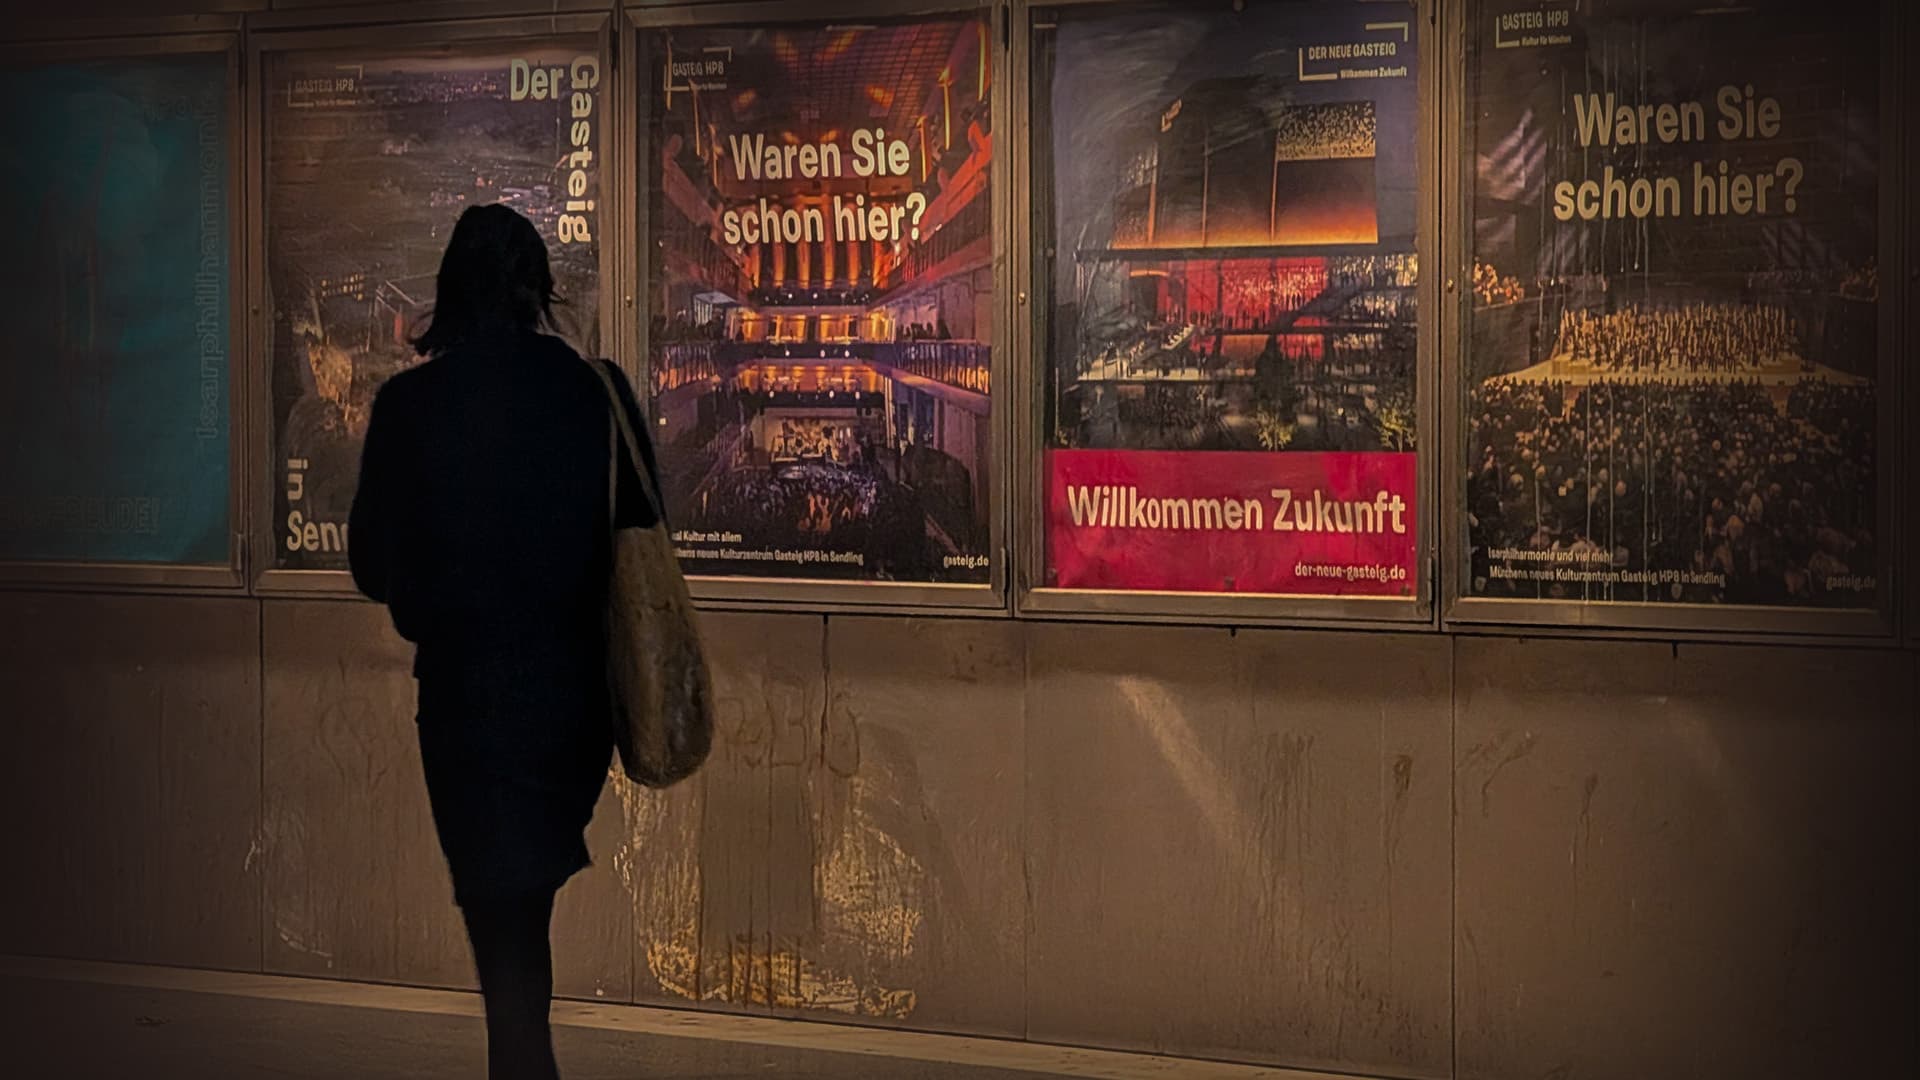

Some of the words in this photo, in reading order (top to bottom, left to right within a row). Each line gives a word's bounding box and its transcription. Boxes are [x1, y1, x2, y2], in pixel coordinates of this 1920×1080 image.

[1502, 11, 1543, 30] GASTEIG
[1547, 10, 1569, 28] HP8
[1309, 46, 1327, 60] DER
[1329, 44, 1351, 59] NEUE
[1353, 42, 1396, 57] GASTEIG
[705, 60, 724, 75] HP8
[1379, 66, 1407, 78] Zukunft
[336, 77, 354, 92] HP8
[510, 58, 564, 101] Der
[1574, 92, 1705, 147] Waren
[1717, 83, 1781, 140] Sie
[558, 56, 600, 244] Gasteig
[729, 133, 841, 180] Waren
[851, 127, 910, 177] Sie
[1553, 165, 1680, 221] schon
[1693, 157, 1804, 216] hier?
[724, 197, 824, 244] schon
[833, 192, 926, 242] hier?
[287, 458, 308, 501] in
[1068, 485, 1263, 530] Willkommen
[1271, 489, 1406, 534] Zukunft
[707, 531, 720, 542] mit
[720, 548, 773, 561] Kulturzentrum
[774, 549, 803, 564] Gasteig
[804, 550, 820, 563] HP8
[821, 550, 829, 563] in
[943, 554, 989, 569] gasteig.de
[1557, 548, 1574, 561] und
[1575, 548, 1590, 562] viel
[1591, 549, 1613, 563] mehr
[1295, 560, 1406, 583] der-neue-gasteig.de
[1555, 567, 1619, 583] Kulturzentrum
[1621, 569, 1658, 586] Gasteig
[1659, 570, 1680, 583] HP8
[1681, 570, 1689, 584] in
